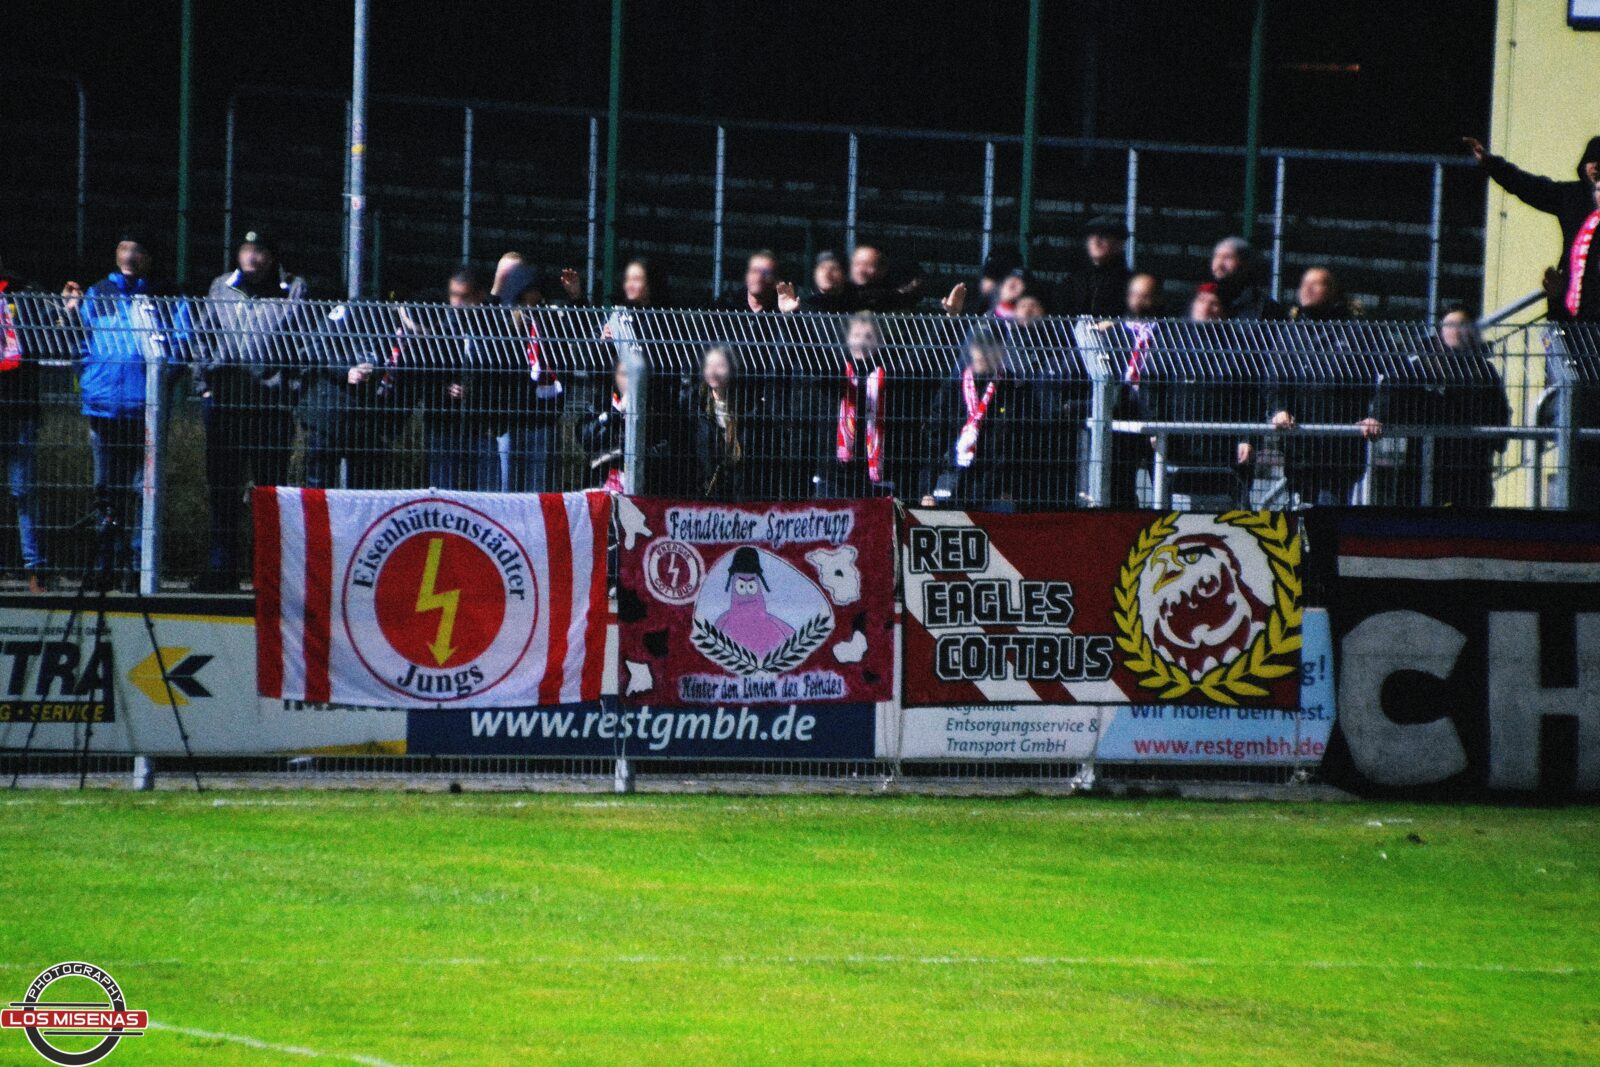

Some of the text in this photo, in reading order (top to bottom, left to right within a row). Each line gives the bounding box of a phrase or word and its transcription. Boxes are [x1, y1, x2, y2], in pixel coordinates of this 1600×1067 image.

[670, 510, 850, 547] Feindlicher Spreetrupp
[352, 506, 526, 601] Eisenhüttenstädter
[909, 526, 989, 574] RED
[655, 578, 693, 597] COTTBUS
[923, 580, 1074, 628] EAGLES
[0, 641, 114, 695] TRA
[936, 633, 1115, 681] COTTBUS
[397, 664, 485, 698] Jungs
[470, 704, 816, 750] www.restgmbh.de
[946, 717, 1099, 736] Entsorgungsservice &
[947, 738, 1067, 756] Transport GmbH
[1133, 736, 1326, 759] www.restgmbh.de
